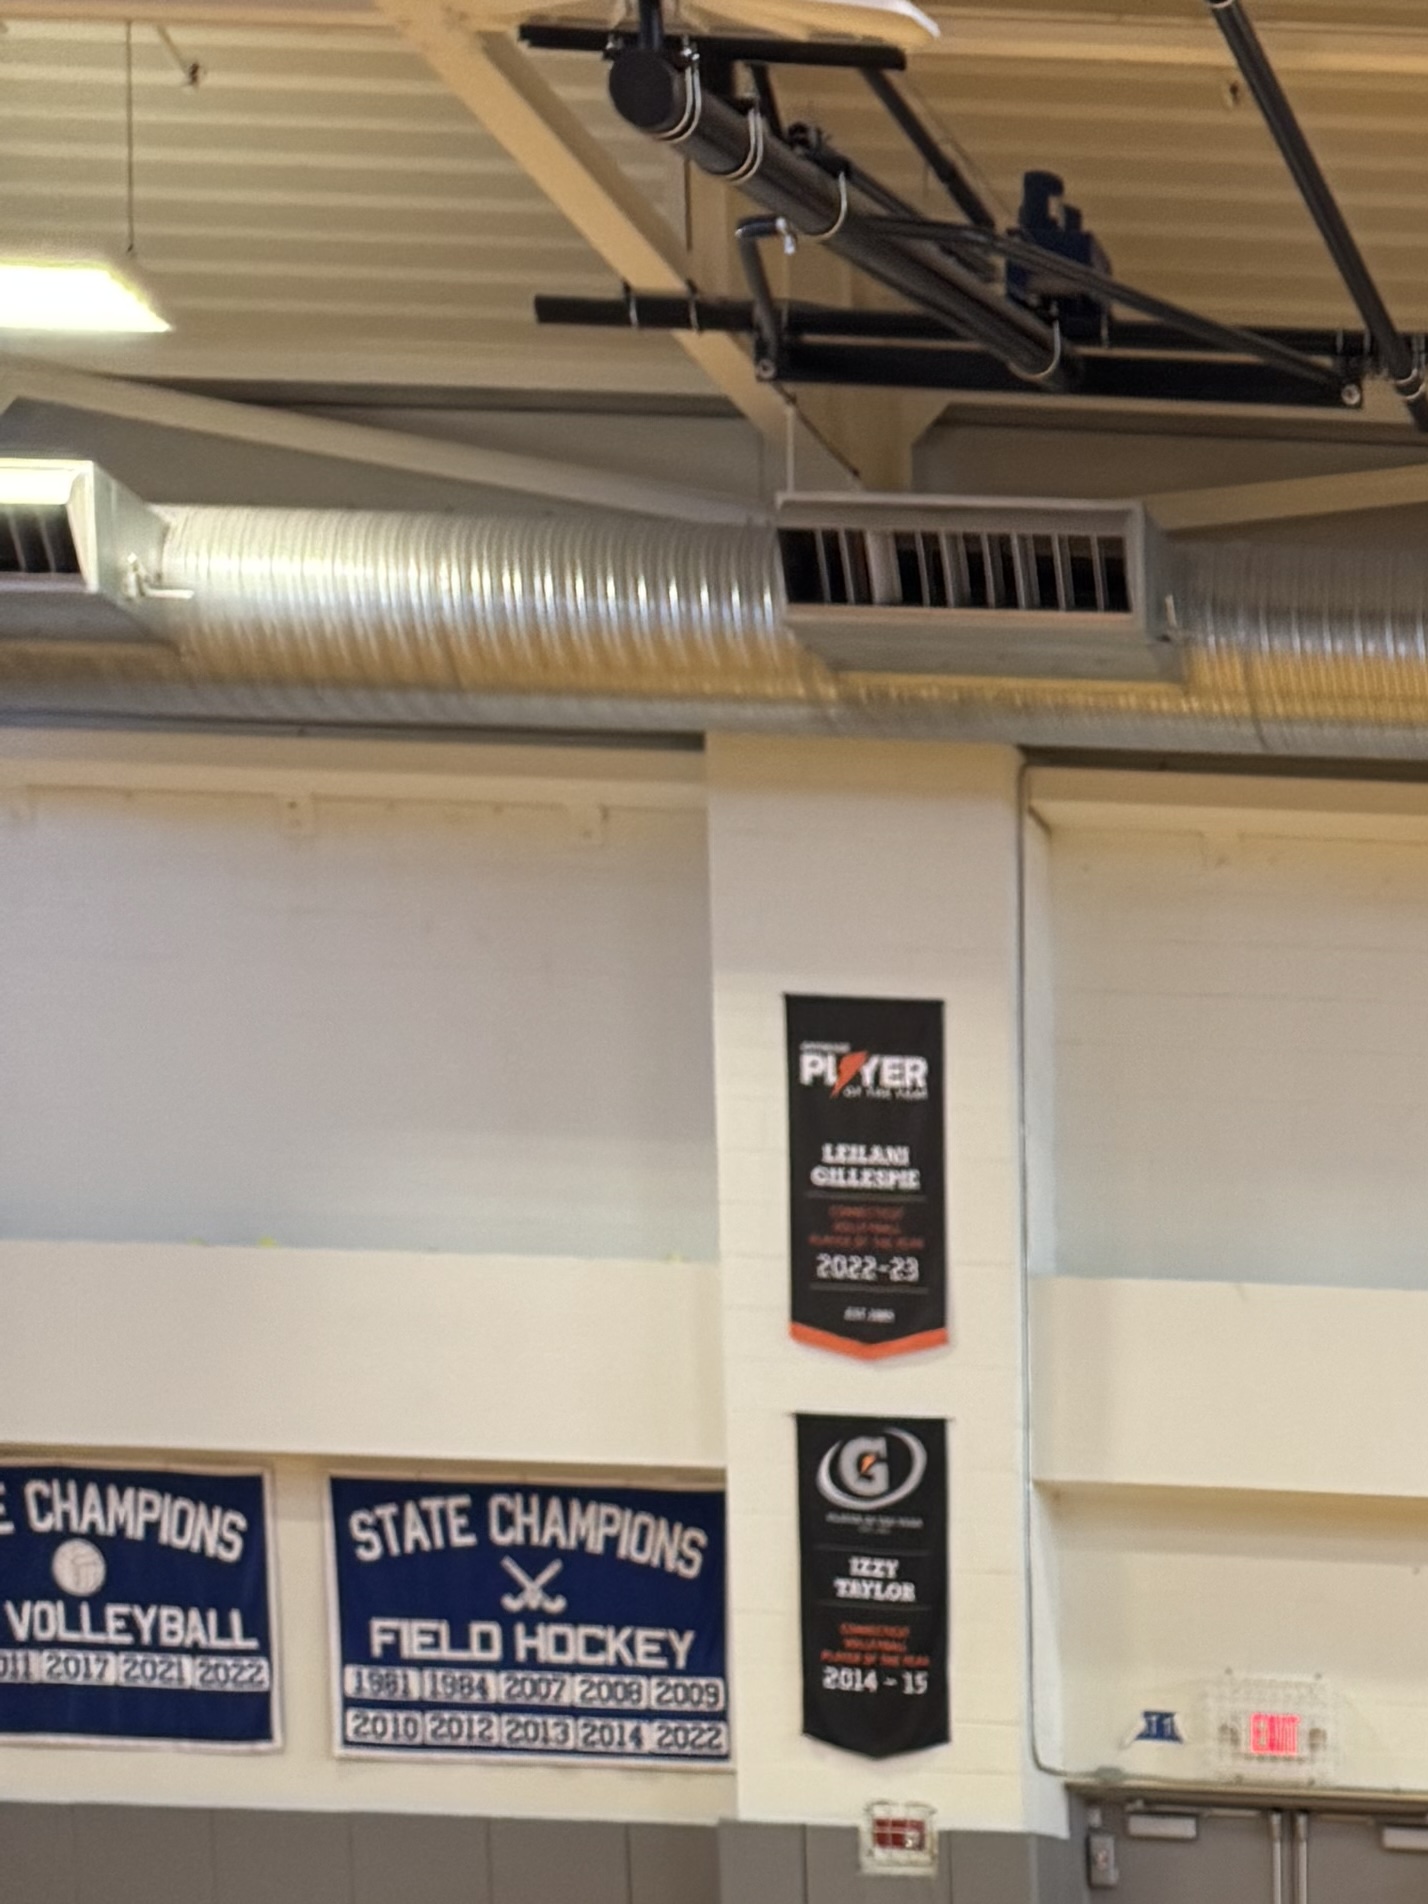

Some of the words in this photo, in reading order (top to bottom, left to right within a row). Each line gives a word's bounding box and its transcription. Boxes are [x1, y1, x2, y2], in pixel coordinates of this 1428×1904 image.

[822, 1142, 910, 1166] LEILANI
[810, 1167, 920, 1190] GILLESPIE
[816, 1253, 920, 1282] 2022-23
[24, 1478, 247, 1563] CHAMPIONS
[349, 1495, 477, 1562] STATE
[489, 1493, 707, 1579] CHAMPIONS
[850, 1556, 899, 1578] IZZY
[833, 1578, 916, 1602] TAYLOR
[5, 1600, 259, 1649] VOLLEYBALL
[370, 1618, 502, 1662] FIELD
[515, 1622, 695, 1669] HOCKEY
[46, 1655, 110, 1681] 2017
[124, 1657, 184, 1682] 2021
[199, 1660, 265, 1685] 2022
[822, 1666, 878, 1693] 2014
[506, 1675, 566, 1701] 2007
[580, 1678, 641, 1704] 2008
[655, 1681, 718, 1708] 2009
[352, 1713, 418, 1740] 2010
[430, 1714, 493, 1741] 2012
[506, 1719, 570, 1745] 2013
[582, 1722, 643, 1749] 2014
[656, 1725, 722, 1750] 2022
